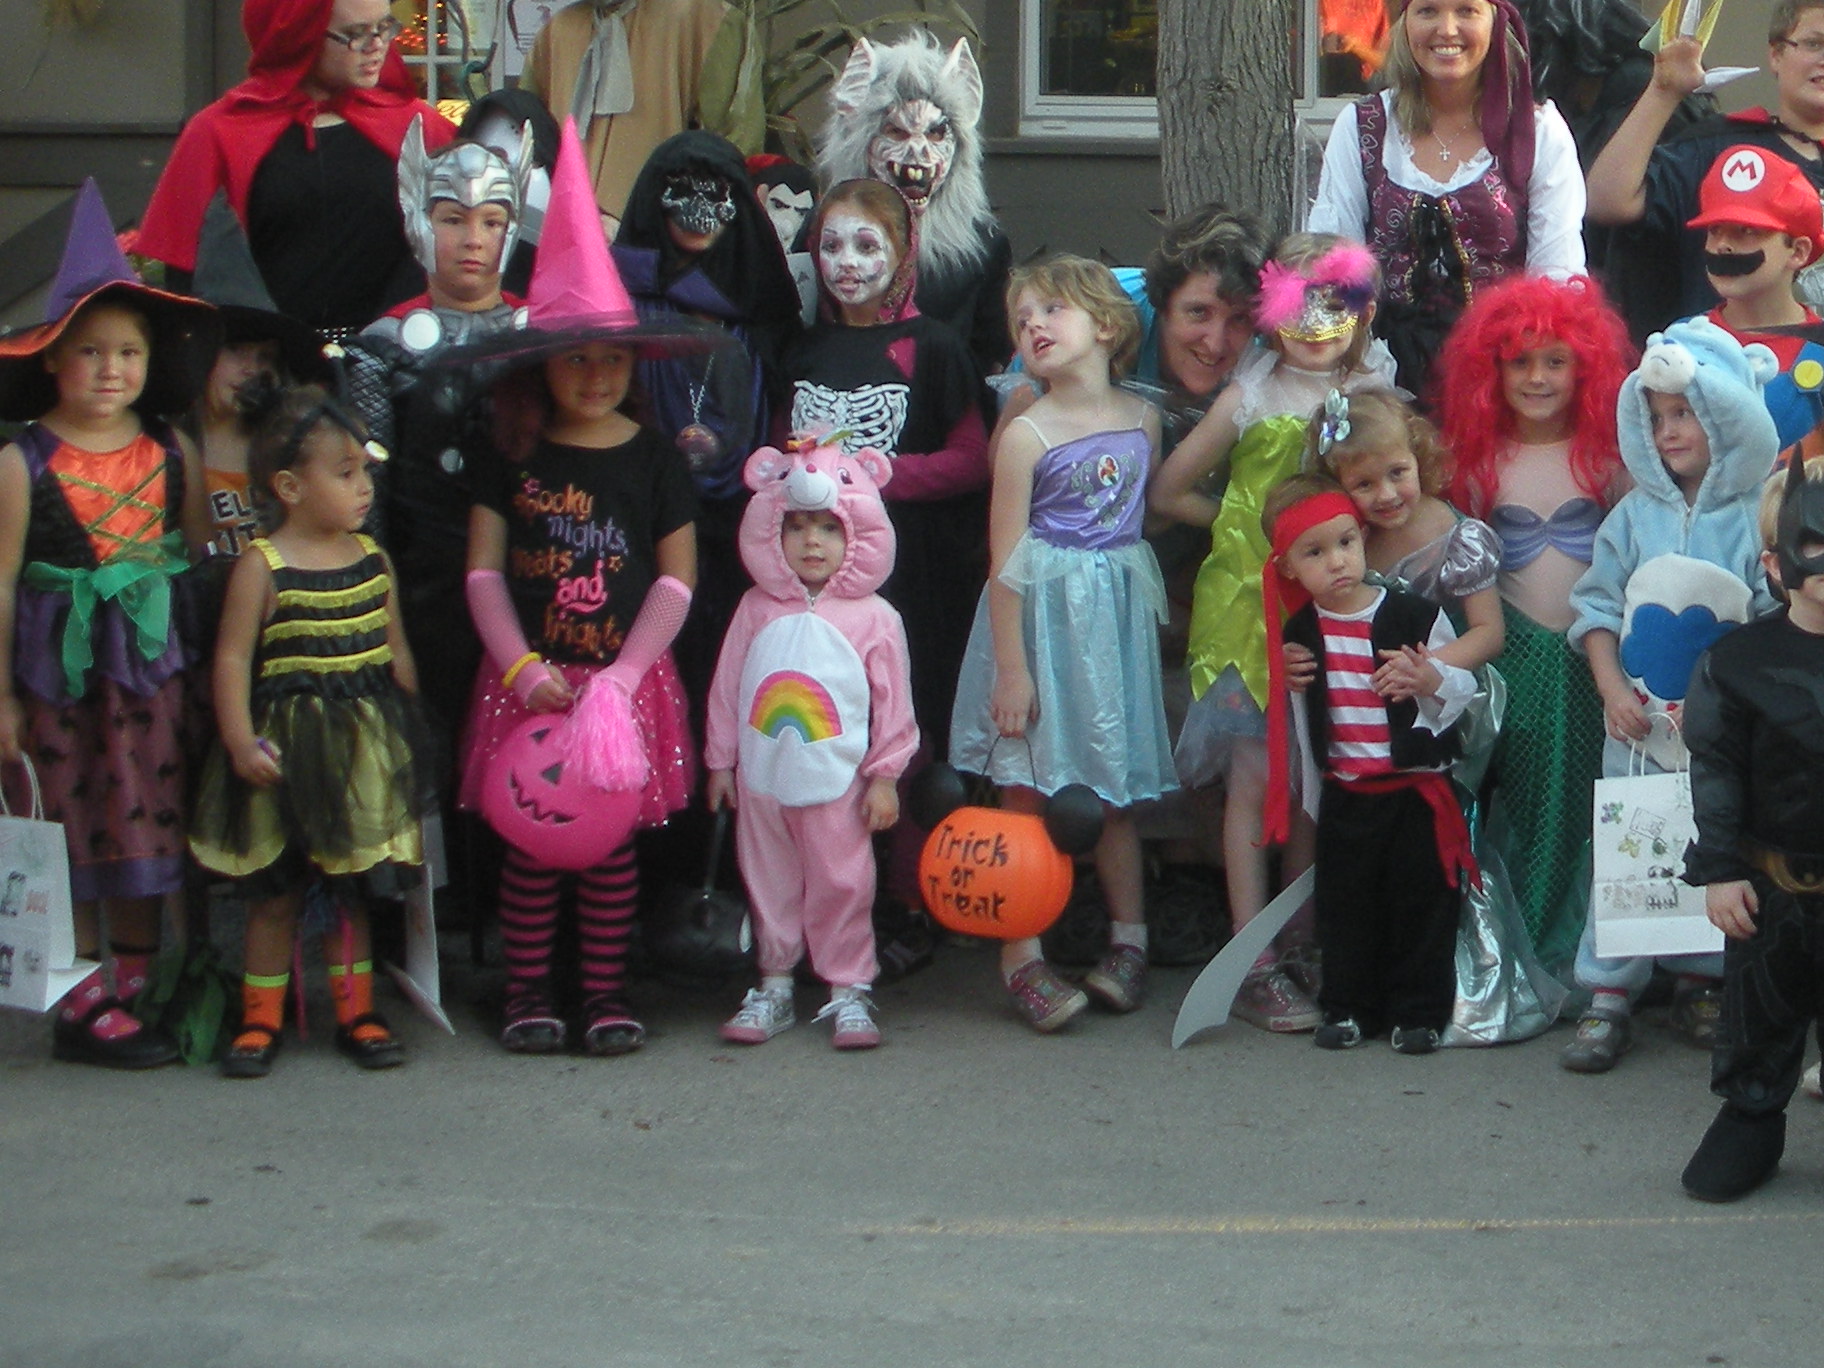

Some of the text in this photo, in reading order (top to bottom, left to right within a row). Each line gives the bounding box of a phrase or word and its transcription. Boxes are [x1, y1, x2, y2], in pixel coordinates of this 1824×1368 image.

[1727, 159, 1757, 181] M
[555, 559, 608, 614] and
[936, 824, 1009, 868] Trick
[927, 874, 1006, 920] Treat
[950, 866, 975, 888] or
